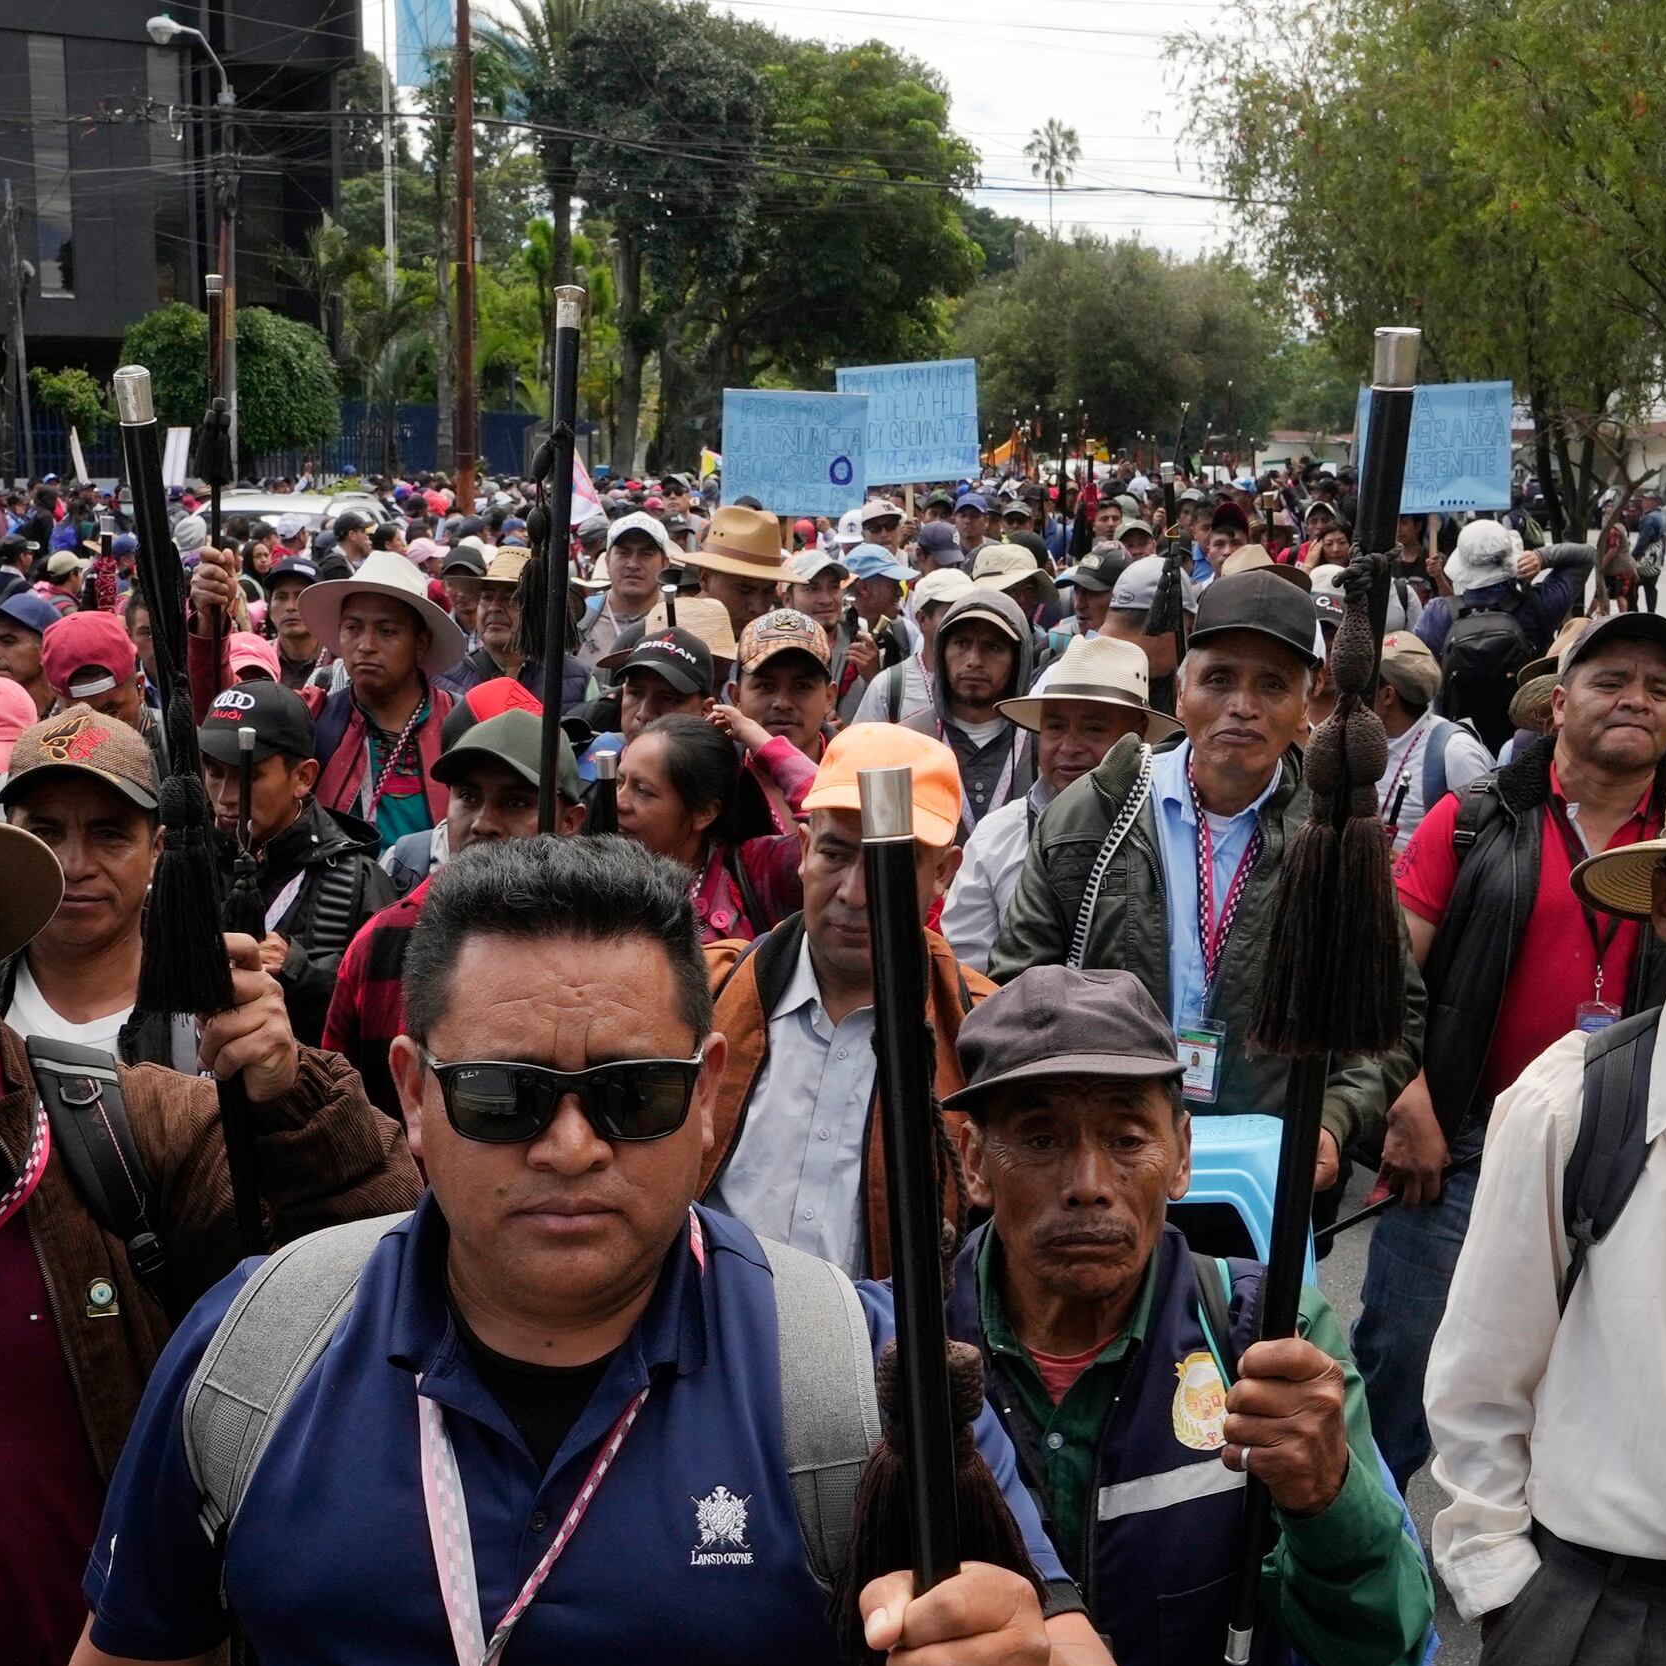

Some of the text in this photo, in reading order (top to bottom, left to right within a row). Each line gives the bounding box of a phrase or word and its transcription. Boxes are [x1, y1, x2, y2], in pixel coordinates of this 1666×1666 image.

[741, 397, 842, 425] PEDIMOS
[1467, 389, 1500, 418] LA
[727, 425, 862, 456] LA RENUNCIA
[1415, 415, 1508, 450] ERANZA
[1405, 449, 1497, 480] ESENTE
[633, 639, 697, 665] JORDAN
[211, 708, 242, 721] Audi
[690, 1550, 755, 1566] LANSDOWNE
